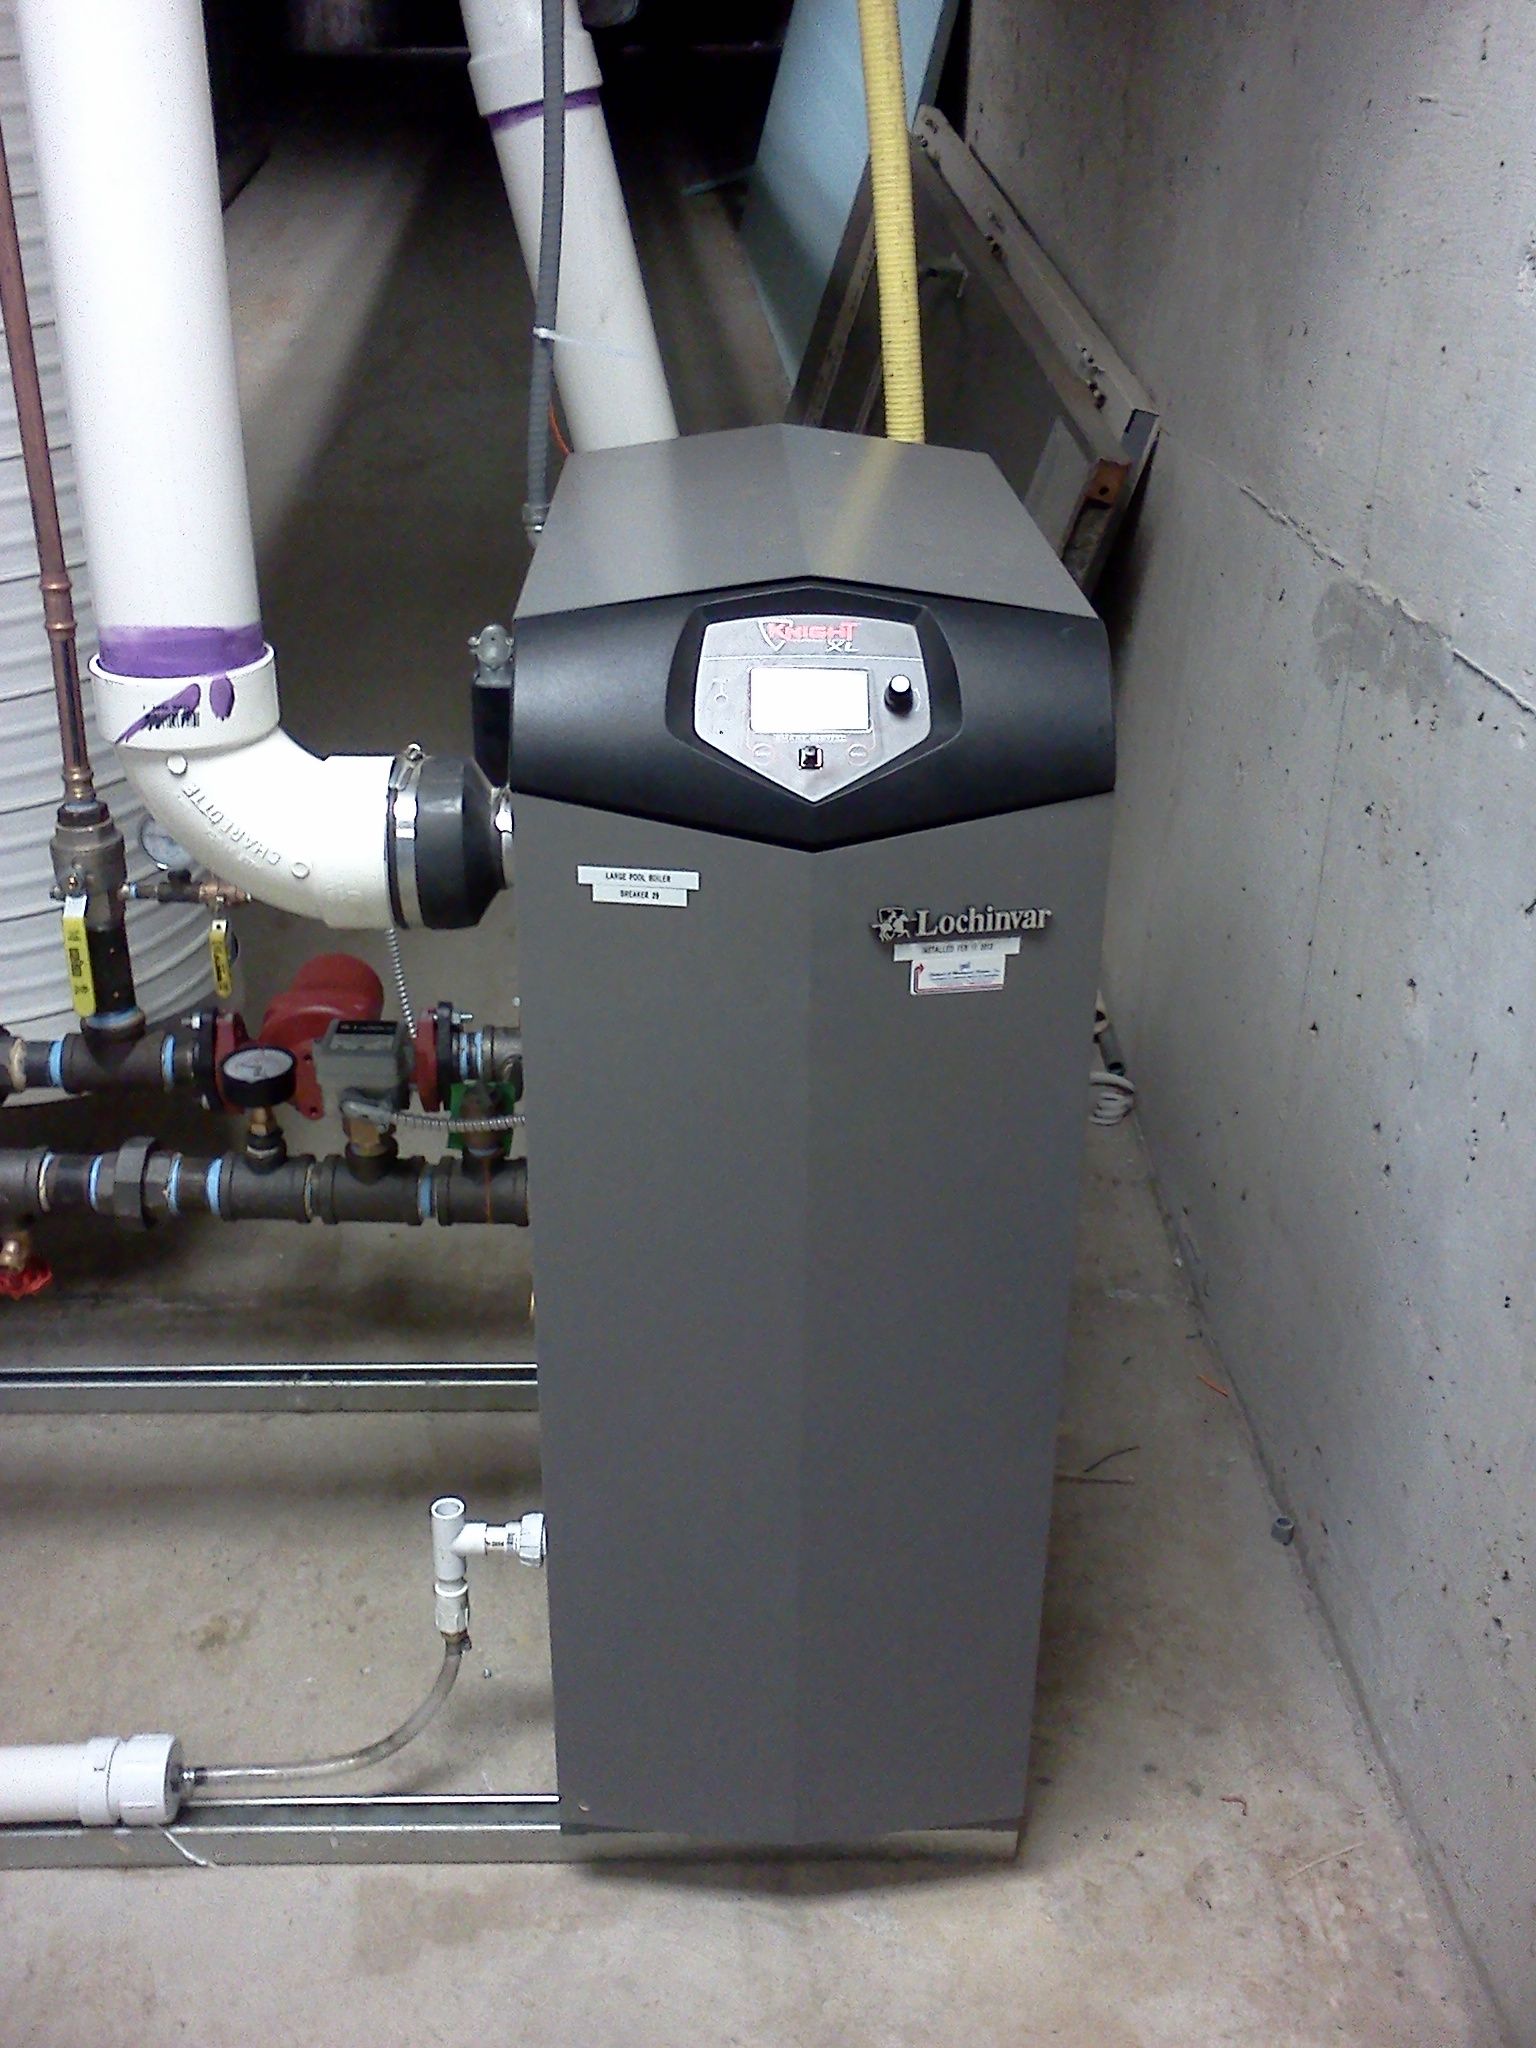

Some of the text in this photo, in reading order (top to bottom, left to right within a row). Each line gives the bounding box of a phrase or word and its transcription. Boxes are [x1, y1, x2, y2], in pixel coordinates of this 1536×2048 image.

[767, 621, 861, 641] KNIGHT
[825, 638, 859, 652] XL
[182, 783, 281, 865] CHARLOTTE
[605, 872, 672, 883] LARGE POOL BOILER
[620, 889, 649, 899] BREAKER
[916, 905, 1052, 937] Lochinvar
